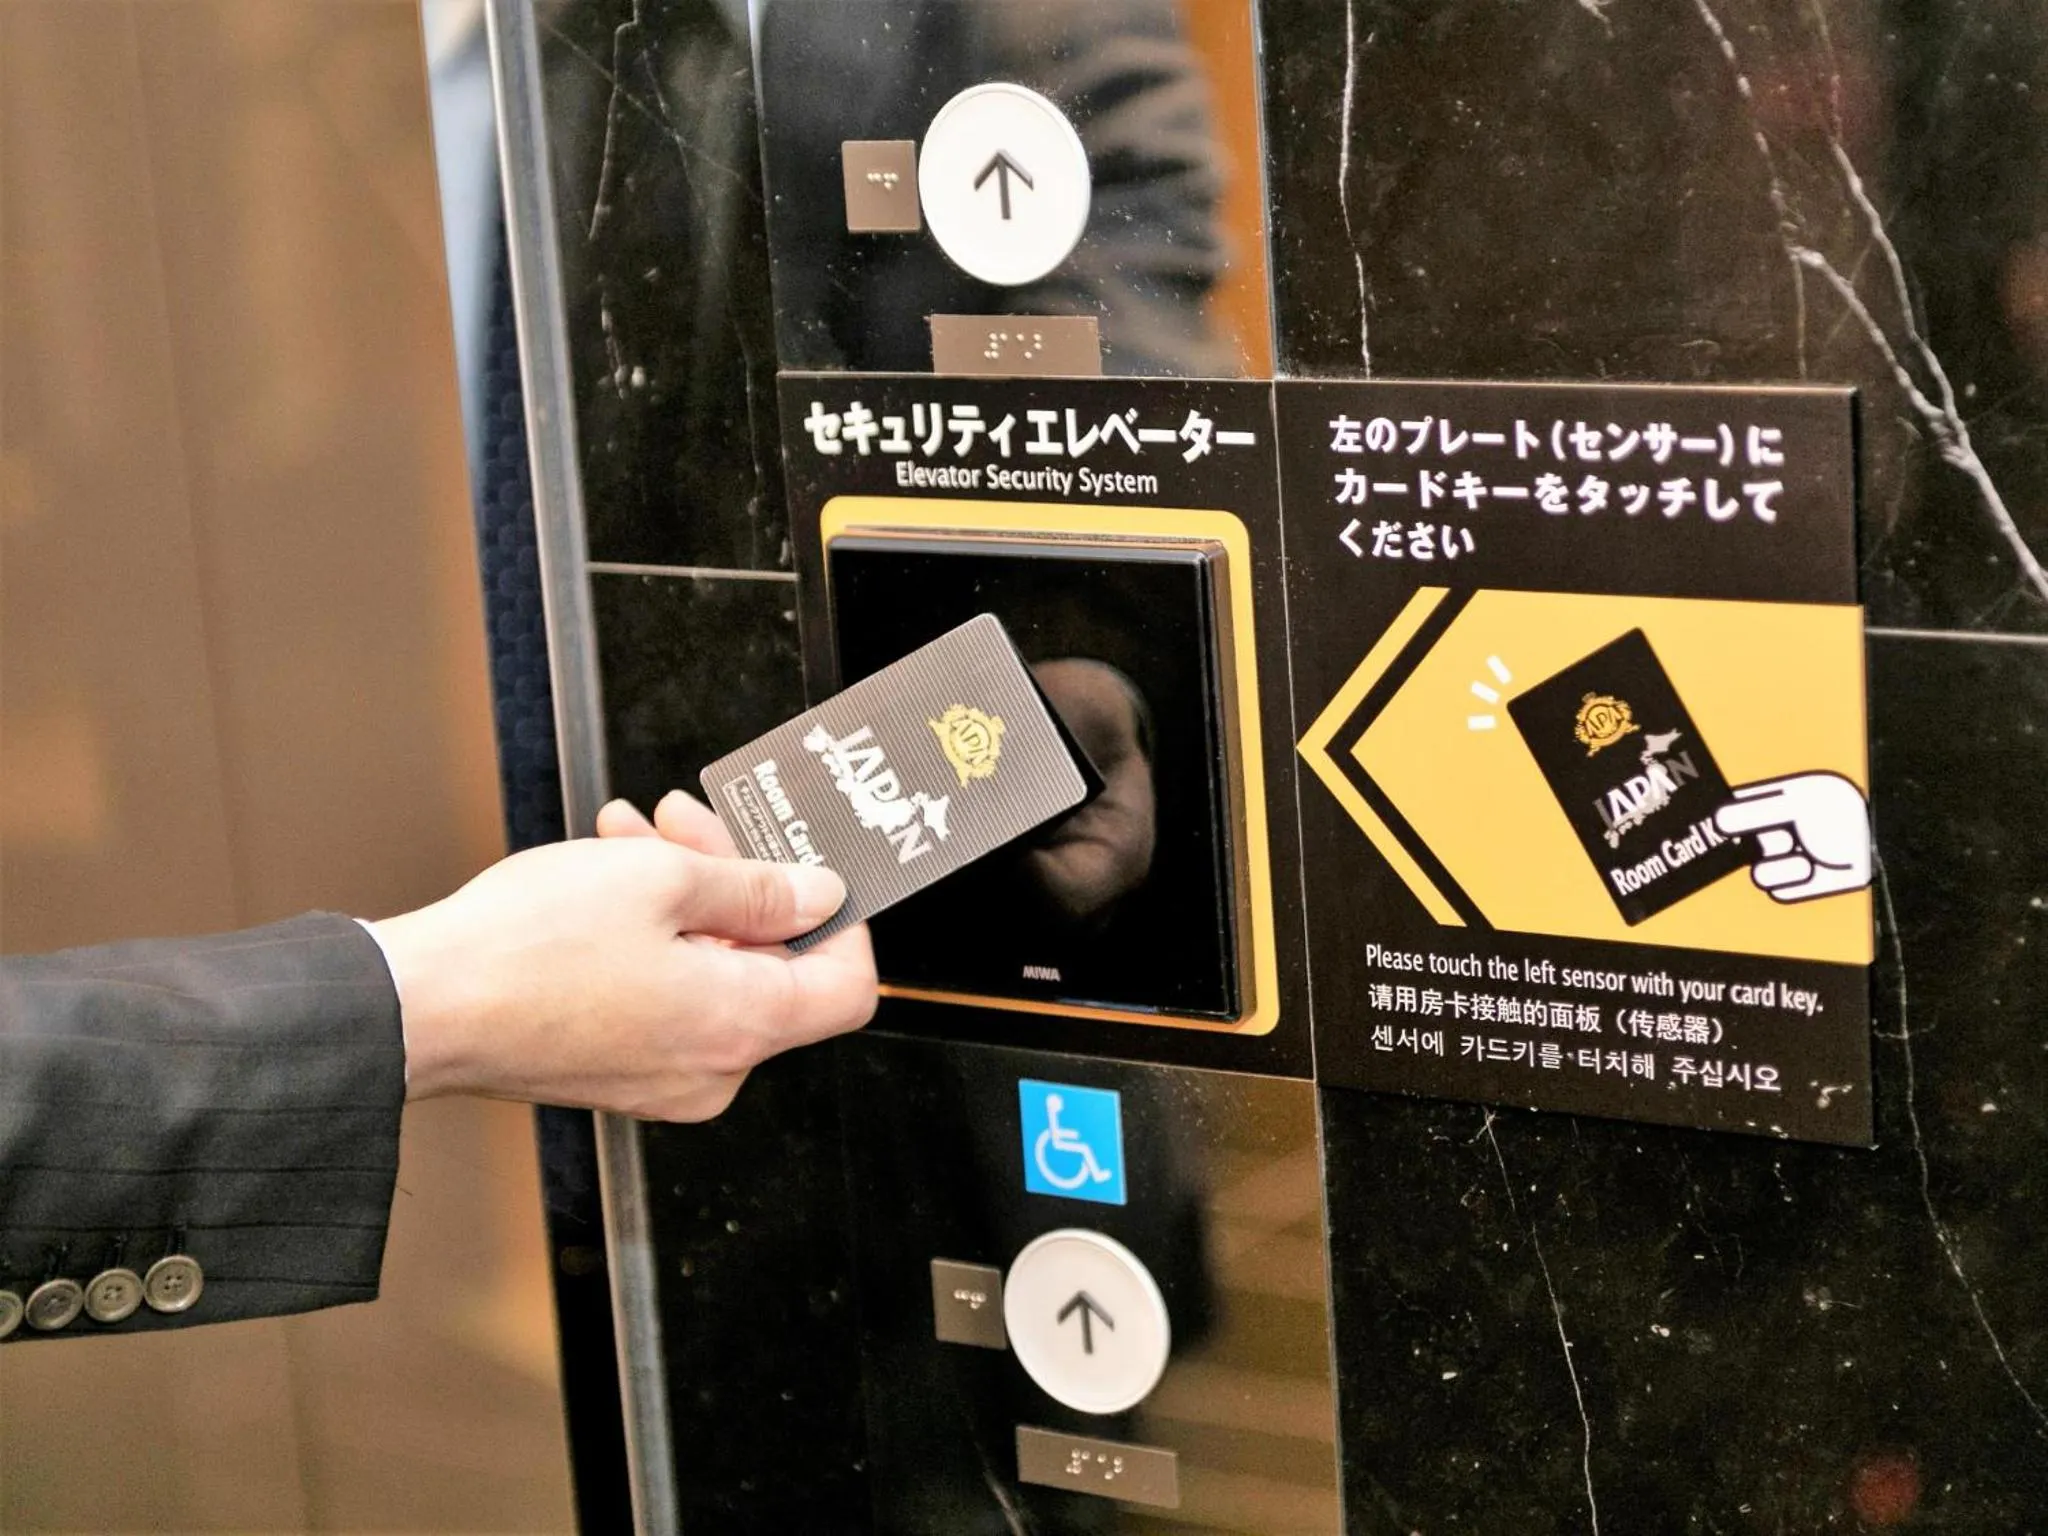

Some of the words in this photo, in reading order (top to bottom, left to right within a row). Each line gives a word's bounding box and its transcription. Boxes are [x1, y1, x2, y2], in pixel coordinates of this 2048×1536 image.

[804, 401, 1256, 464] セキュリティエレベーター
[896, 460, 981, 488] Elevator
[986, 463, 1073, 493] Security
[1078, 466, 1159, 497] System
[1334, 467, 1784, 523] カードキーをタッチして
[1338, 518, 1475, 560] ください
[752, 758, 796, 822] Room
[1593, 751, 1699, 829] JAPAN
[1610, 854, 1668, 897] Room
[1661, 824, 1708, 868] Card
[1366, 944, 1424, 972] Please
[1429, 952, 1482, 979] touch
[1488, 956, 1519, 982] the
[1524, 959, 1556, 986] left
[1562, 968, 1627, 992] sensor
[1631, 971, 1674, 997] with
[1679, 980, 1726, 1005] your
[1730, 982, 1777, 1008] card
[1781, 983, 1824, 1018] key.
[1370, 1024, 1444, 1057] 센서에
[1460, 1034, 1564, 1070] 카드키를
[1578, 1046, 1656, 1081] 터치해
[1671, 1056, 1782, 1092] 주십시오
